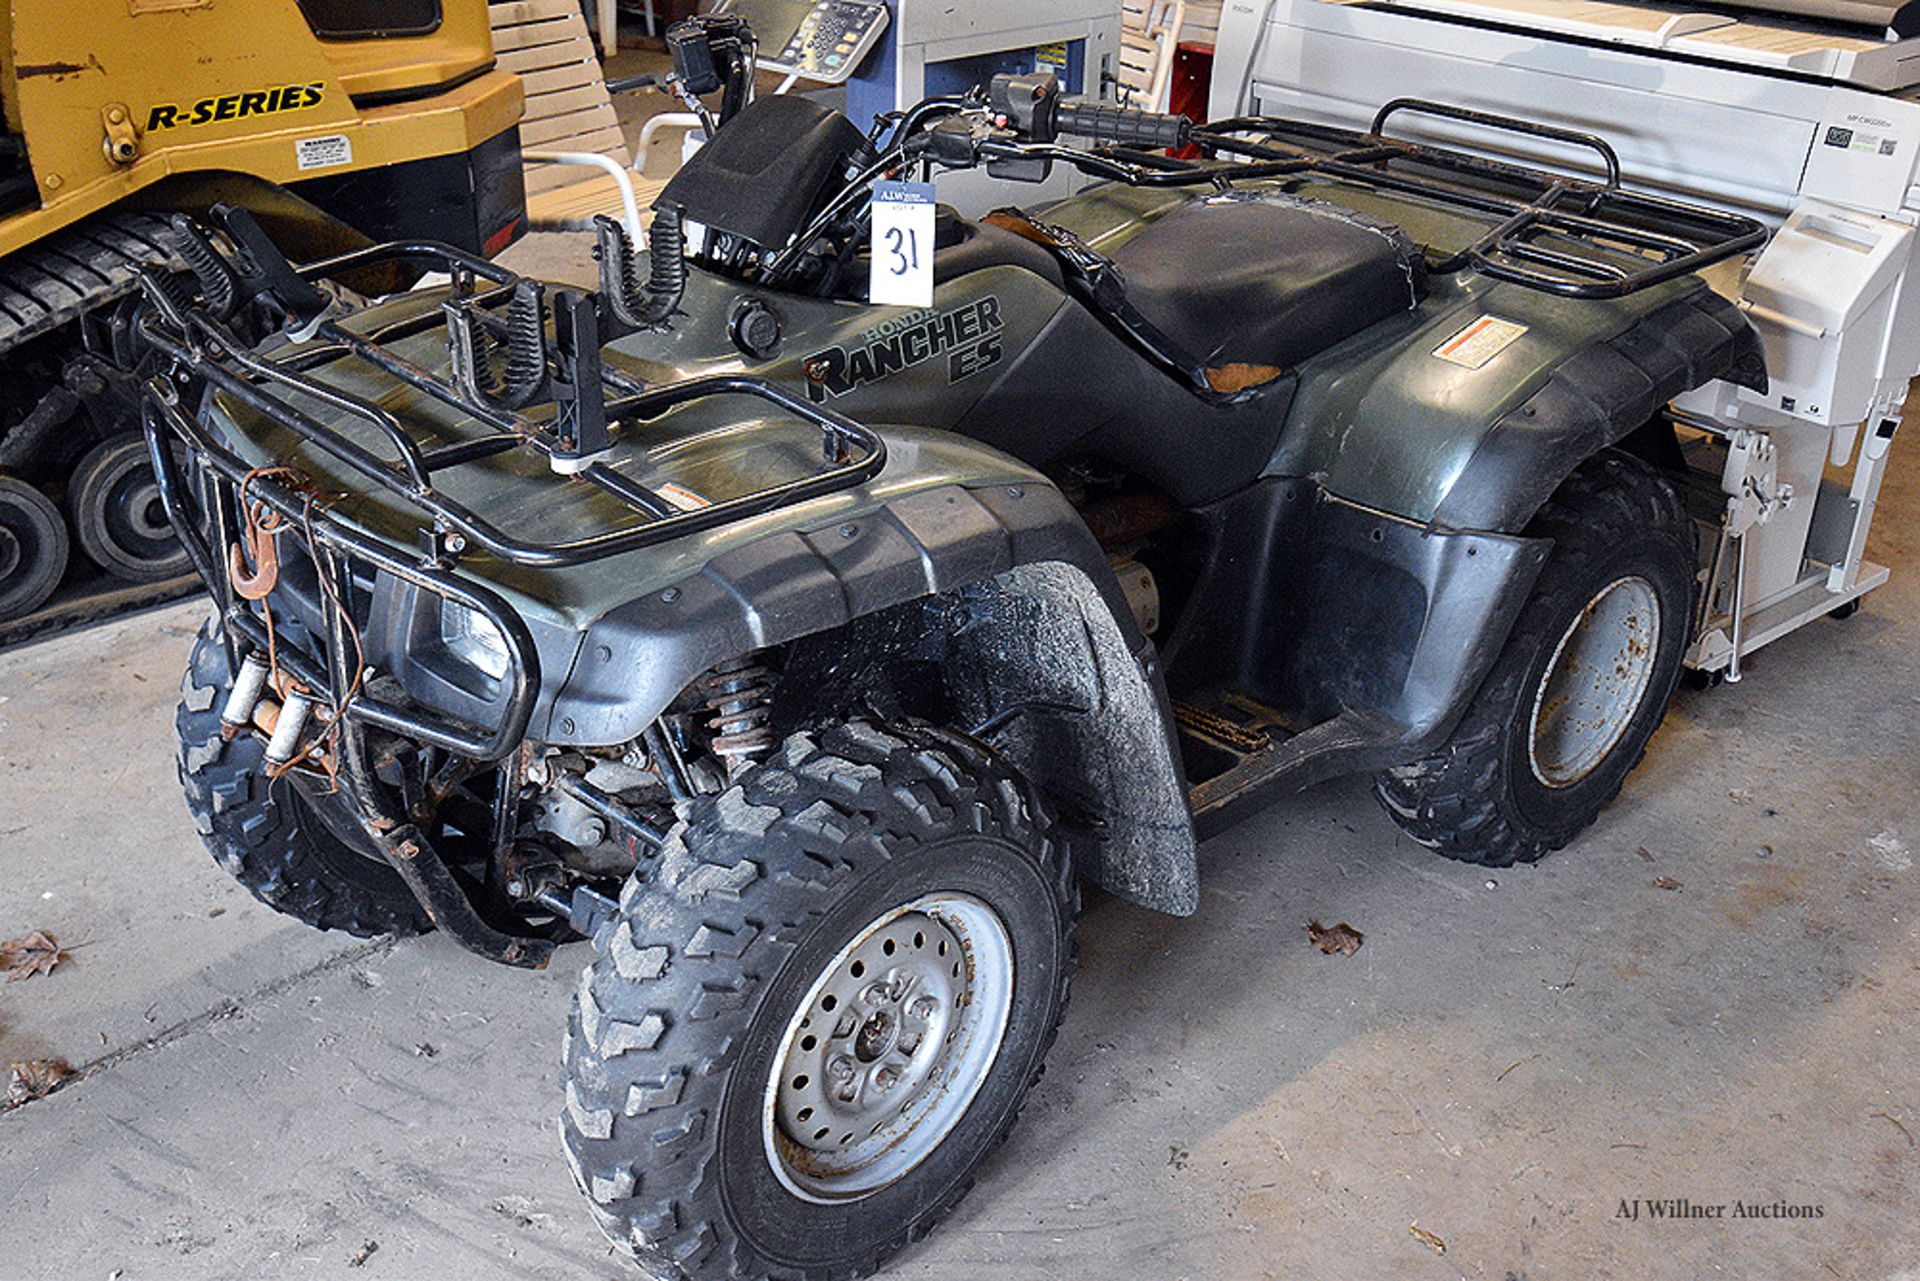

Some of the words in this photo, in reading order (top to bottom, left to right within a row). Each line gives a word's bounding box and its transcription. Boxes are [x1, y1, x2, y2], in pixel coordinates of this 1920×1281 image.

[147, 81, 326, 131] R-SERIES
[884, 226, 918, 275] 31
[802, 294, 1005, 404] RANCHER
[862, 307, 939, 342] HONDA
[948, 333, 1003, 385] ES
